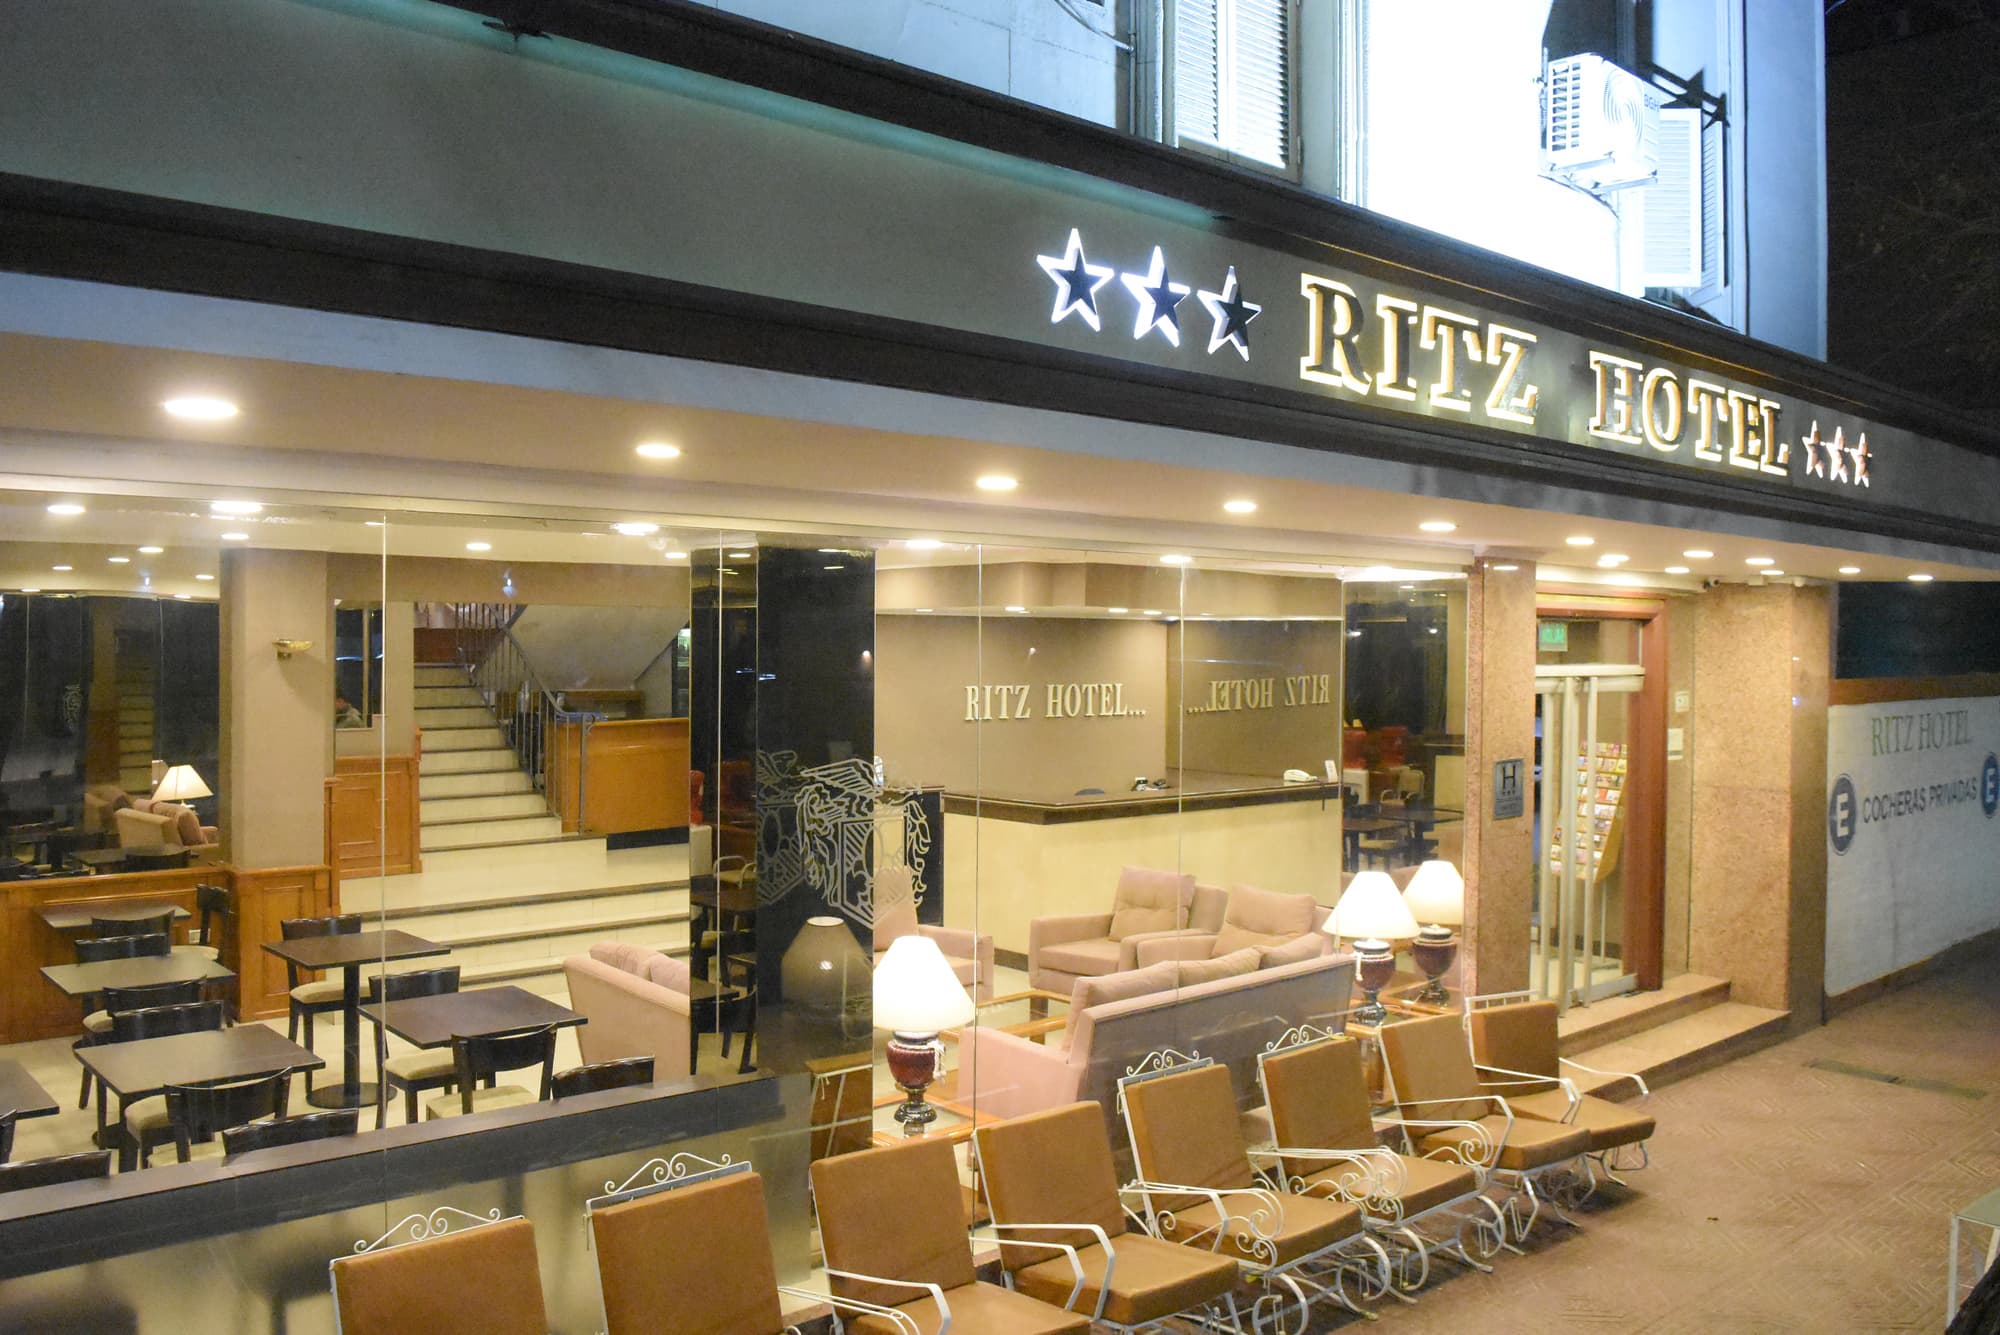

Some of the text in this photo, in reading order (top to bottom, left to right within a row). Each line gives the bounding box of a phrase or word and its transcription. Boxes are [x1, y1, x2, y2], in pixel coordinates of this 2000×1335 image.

[1300, 272, 1788, 477] RITZ HOTEL
[964, 684, 1031, 721] RITZ
[1871, 709, 1973, 756] RITZ HOTEL
[1502, 764, 1516, 789] H
[1985, 767, 1996, 804] E
[1836, 792, 1850, 838] E
[1862, 787, 1927, 824] COCHERAS
